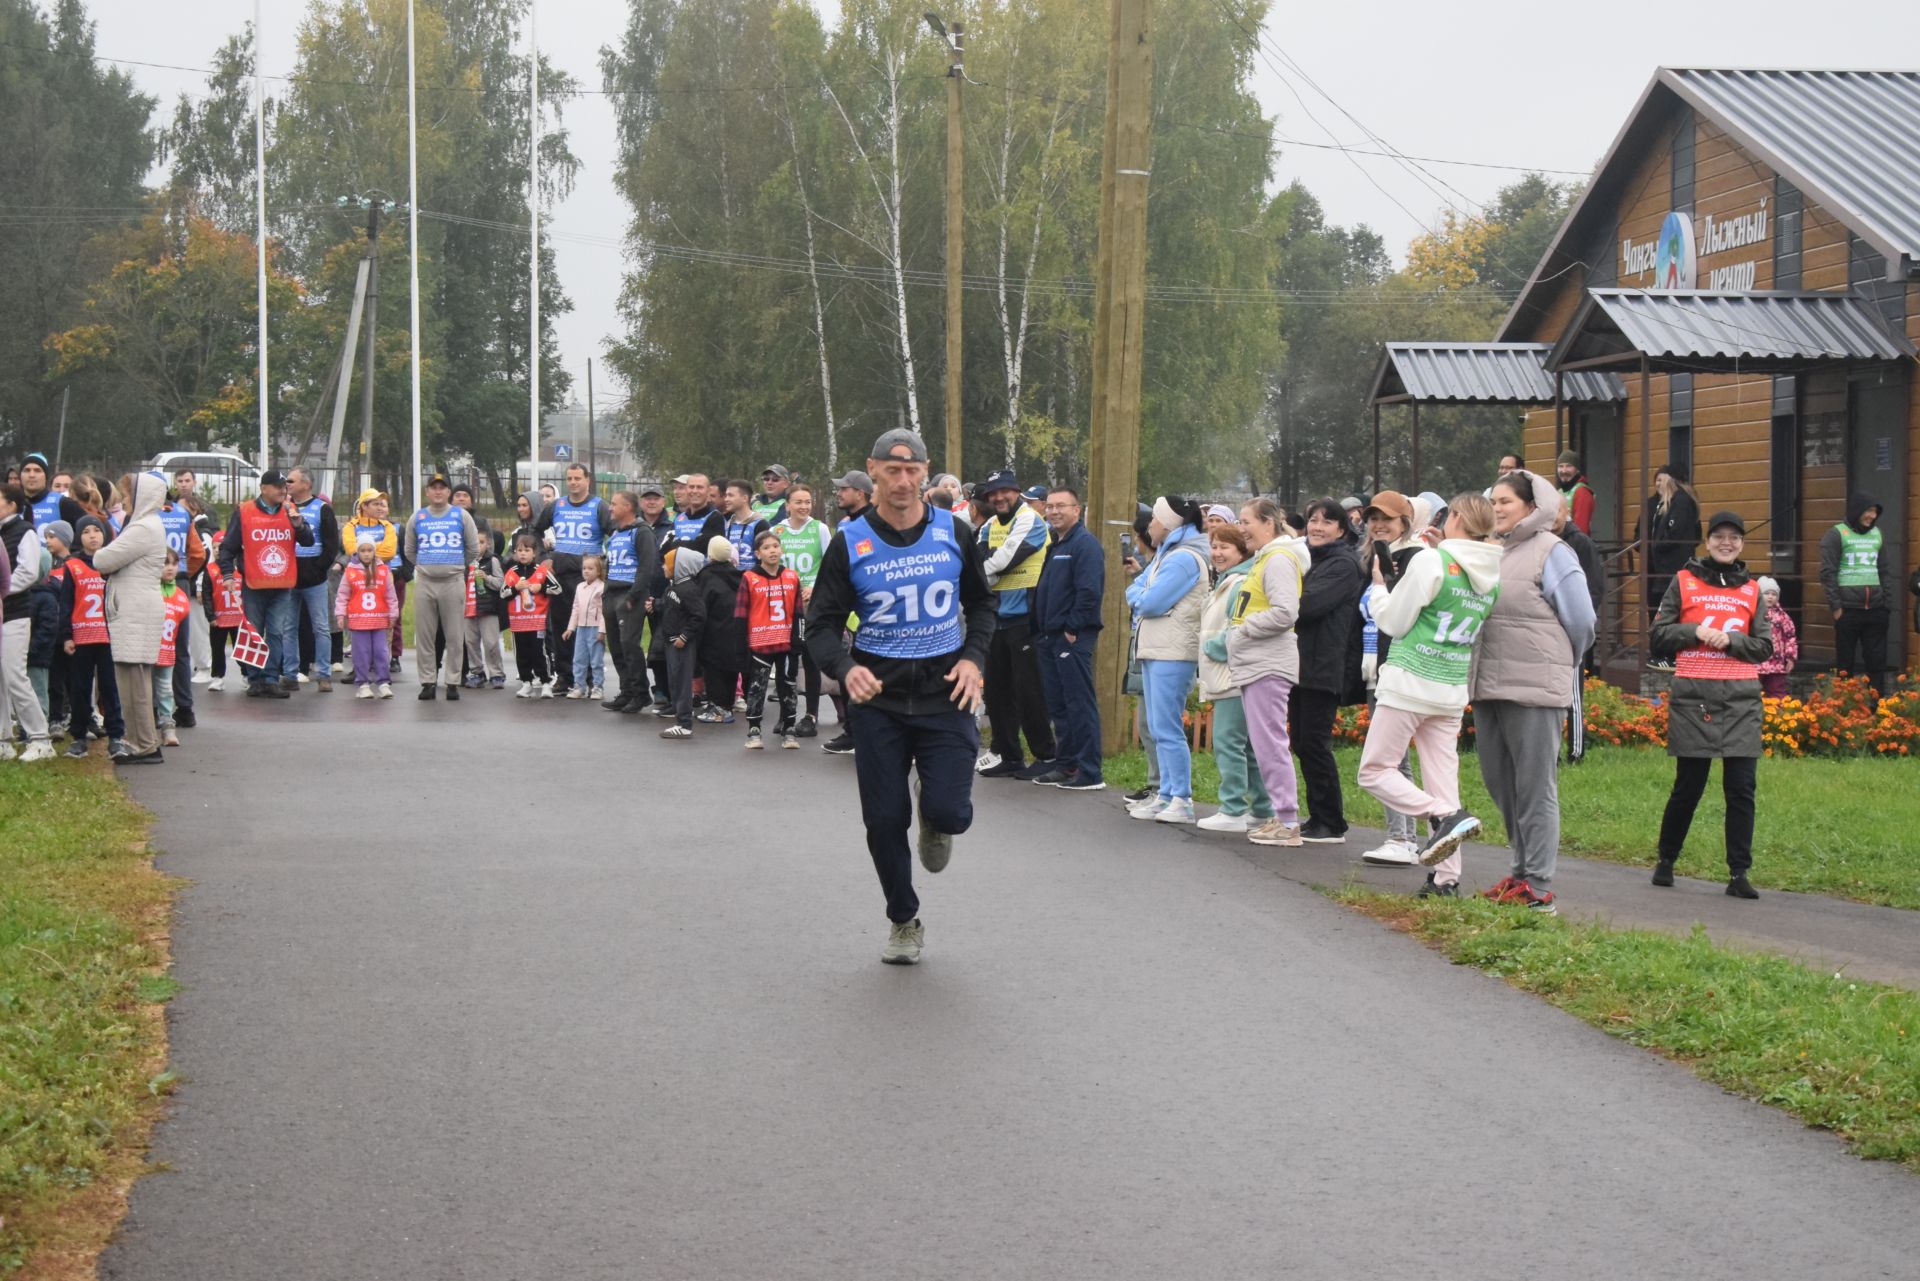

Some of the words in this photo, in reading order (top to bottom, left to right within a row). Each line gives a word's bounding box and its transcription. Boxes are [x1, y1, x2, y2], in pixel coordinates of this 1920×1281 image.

[1700, 197, 1767, 256] Лыжный
[251, 528, 292, 542] СУДЬЯ
[418, 532, 462, 548] 208
[554, 522, 593, 540] 216
[864, 550, 951, 576] ТУКАЕВСКИЙ
[885, 564, 934, 582] РАЙОН
[361, 591, 377, 611] 8
[864, 579, 954, 624] 210
[1235, 590, 1251, 618] 7
[1461, 599, 1486, 613] РАЙОН
[1690, 595, 1749, 608] ТУКАЕВСКИЙ
[1704, 602, 1736, 612] РАЙОН
[769, 599, 786, 622] 3
